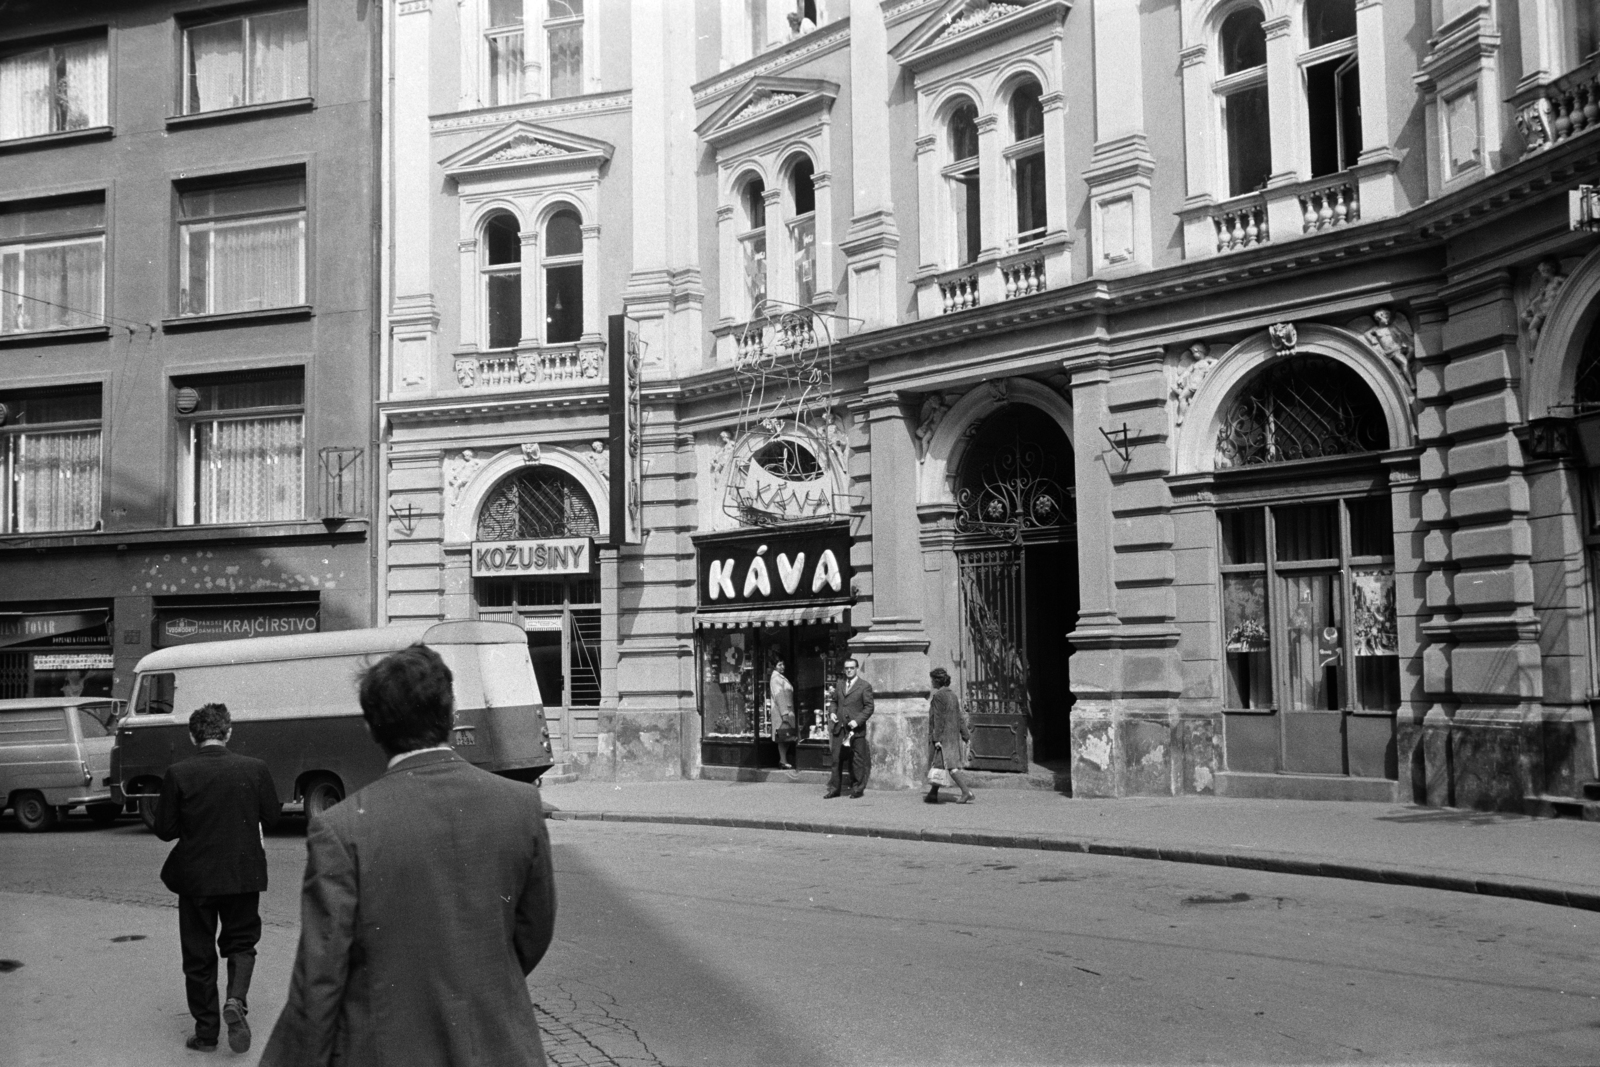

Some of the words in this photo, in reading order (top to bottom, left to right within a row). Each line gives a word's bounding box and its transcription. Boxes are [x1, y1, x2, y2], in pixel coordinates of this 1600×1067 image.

[476, 543, 585, 572] KOŽUŠINY
[708, 544, 842, 600] KÁVA
[25, 620, 55, 634] TOVAR
[223, 616, 317, 637] KRAJČÍRSTVO
